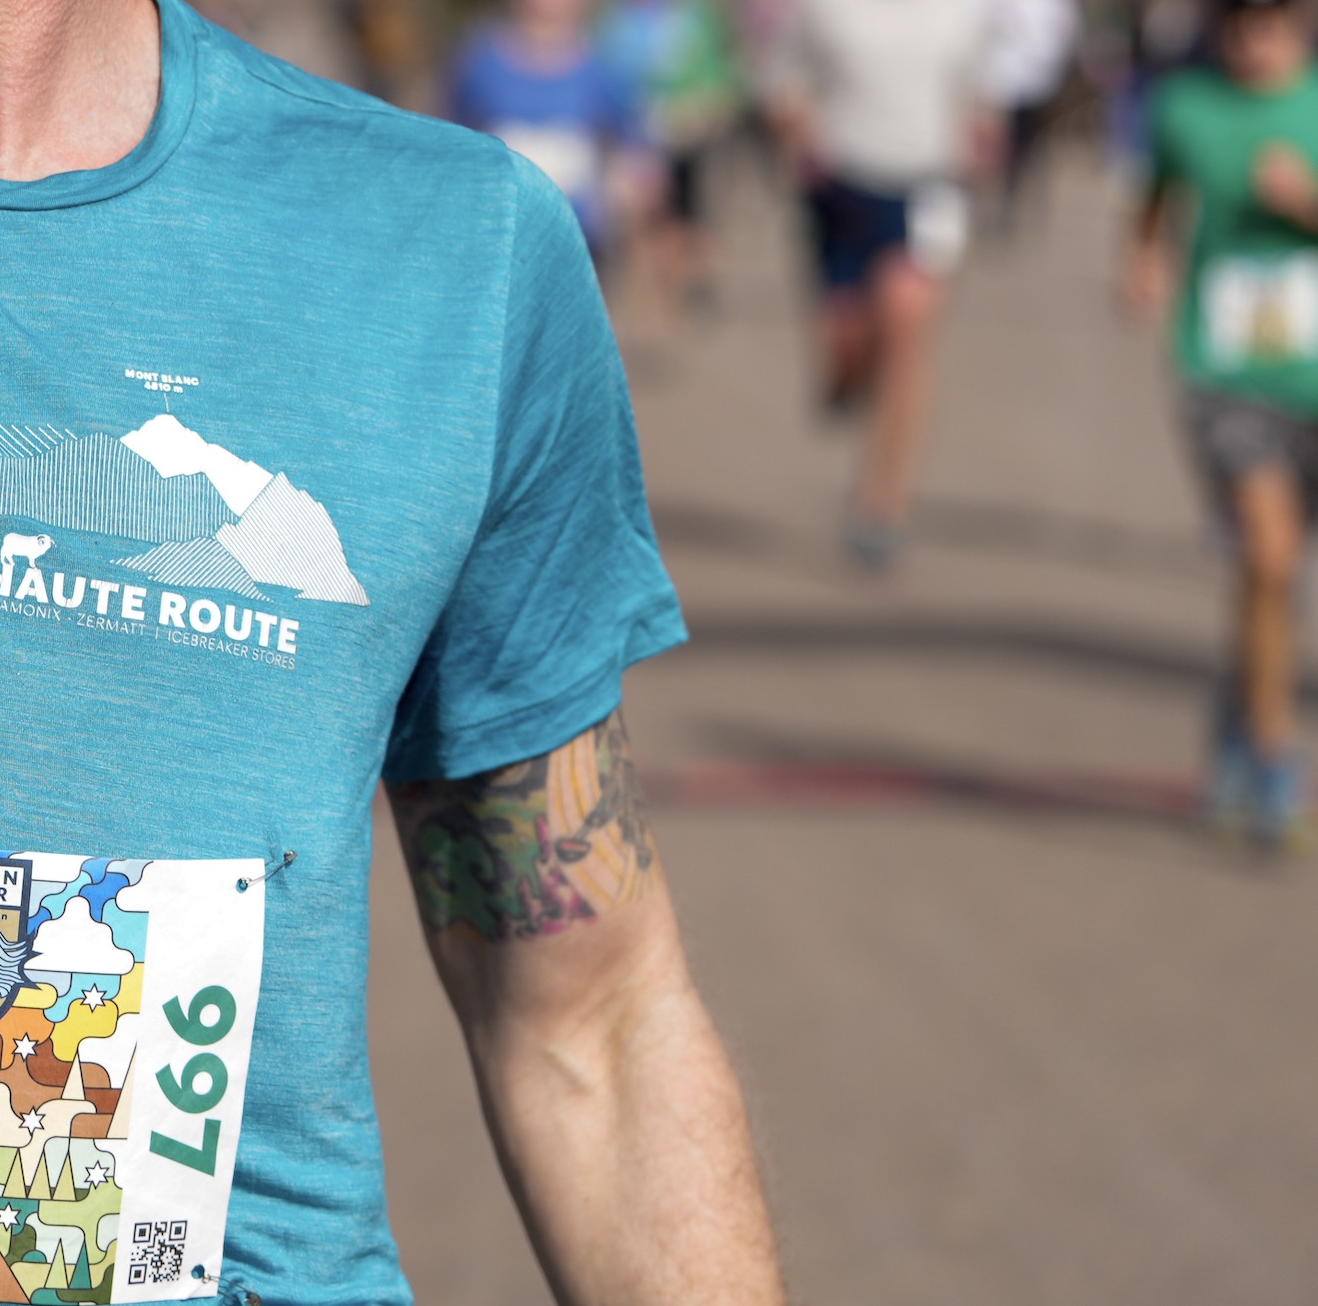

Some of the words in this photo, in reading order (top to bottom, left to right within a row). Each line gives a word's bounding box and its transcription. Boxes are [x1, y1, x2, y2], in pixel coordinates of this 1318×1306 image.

[125, 369, 159, 381] MONT
[161, 374, 200, 386] BLANC
[144, 381, 171, 392] 4810
[76, 613, 147, 636] ZERMATT
[168, 631, 249, 658] ICEBREAKER
[252, 649, 296, 670] STORES
[159, 591, 300, 654] ROUTE
[149, 985, 237, 1177] 997
